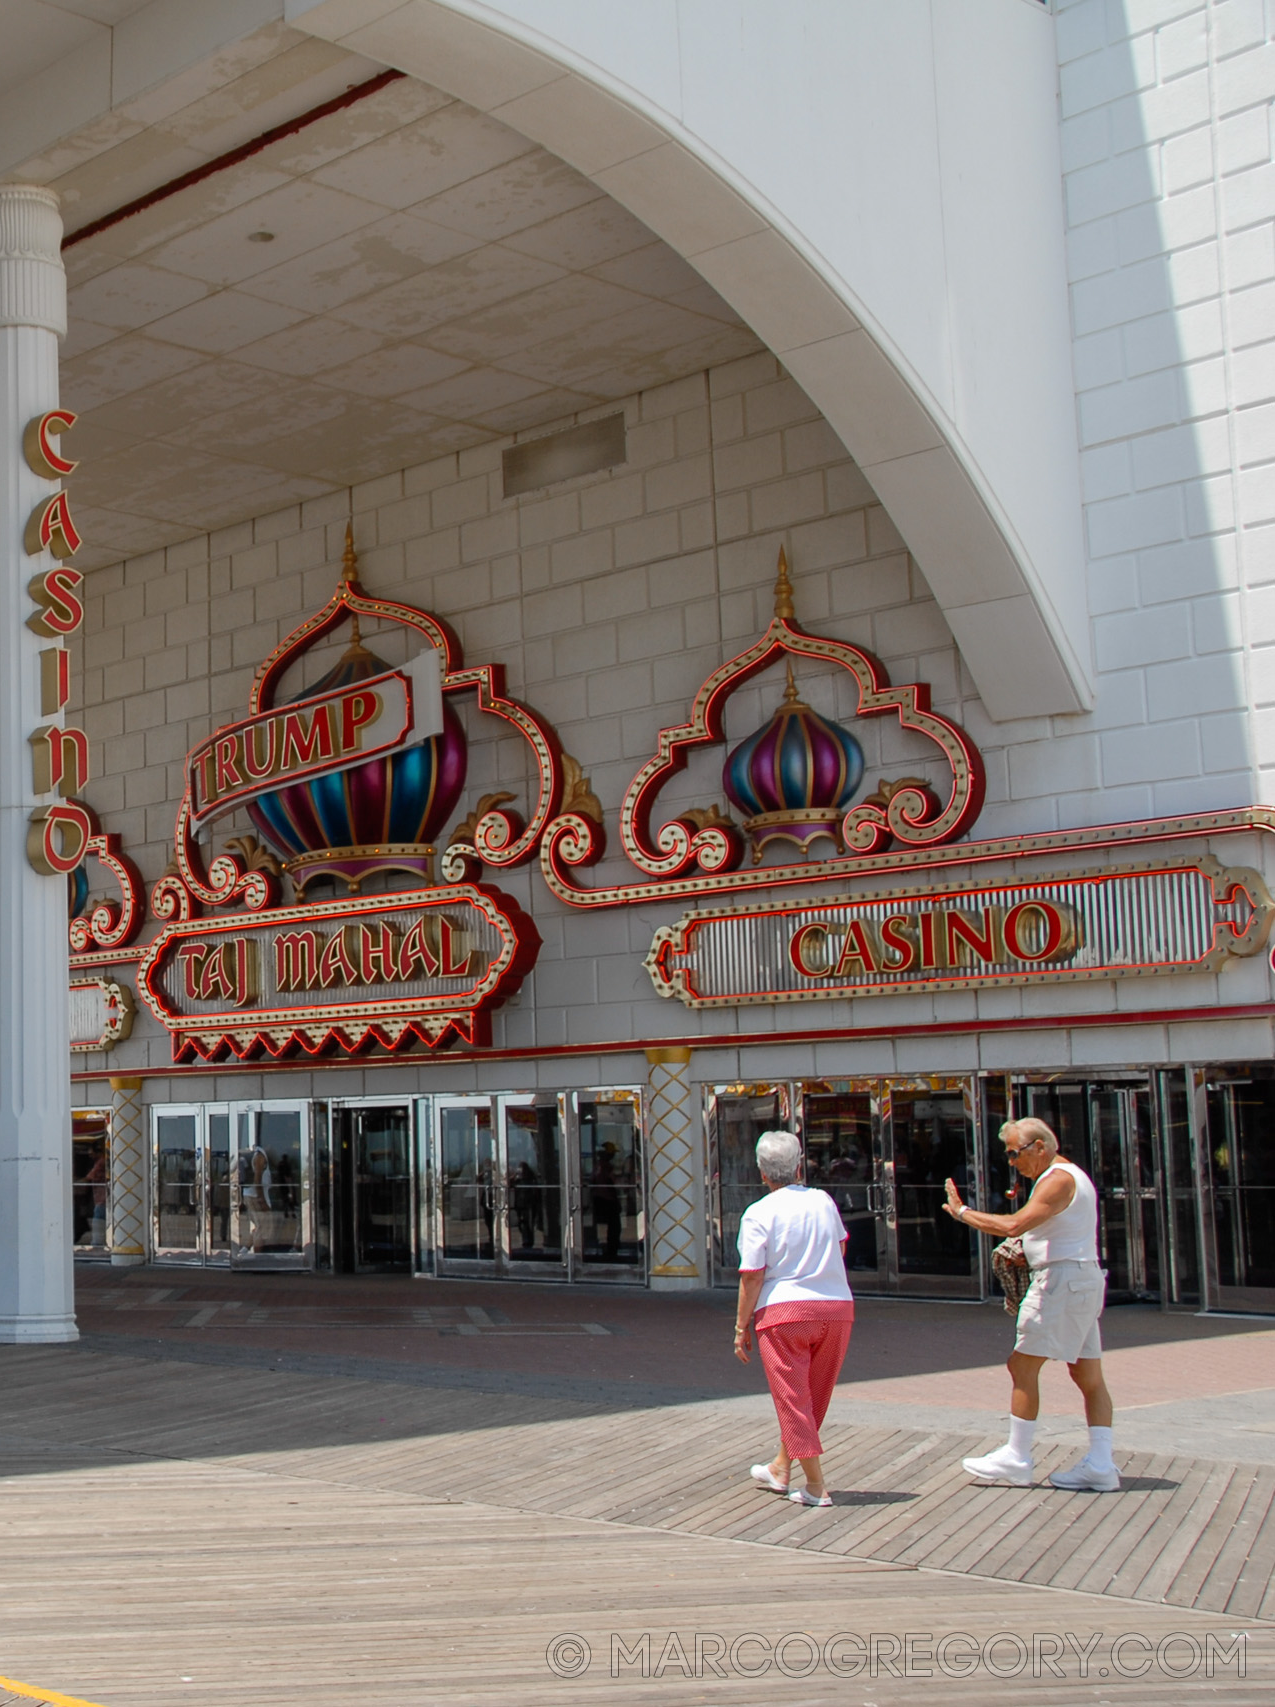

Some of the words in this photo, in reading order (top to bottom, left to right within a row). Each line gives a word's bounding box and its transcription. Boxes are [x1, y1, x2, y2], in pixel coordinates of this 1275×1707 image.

[34, 408, 91, 875] CASINO
[193, 690, 378, 804] TRUMP
[177, 934, 247, 1008] TAJ
[273, 914, 476, 993] MAHAL
[788, 900, 1063, 979] CASINO
